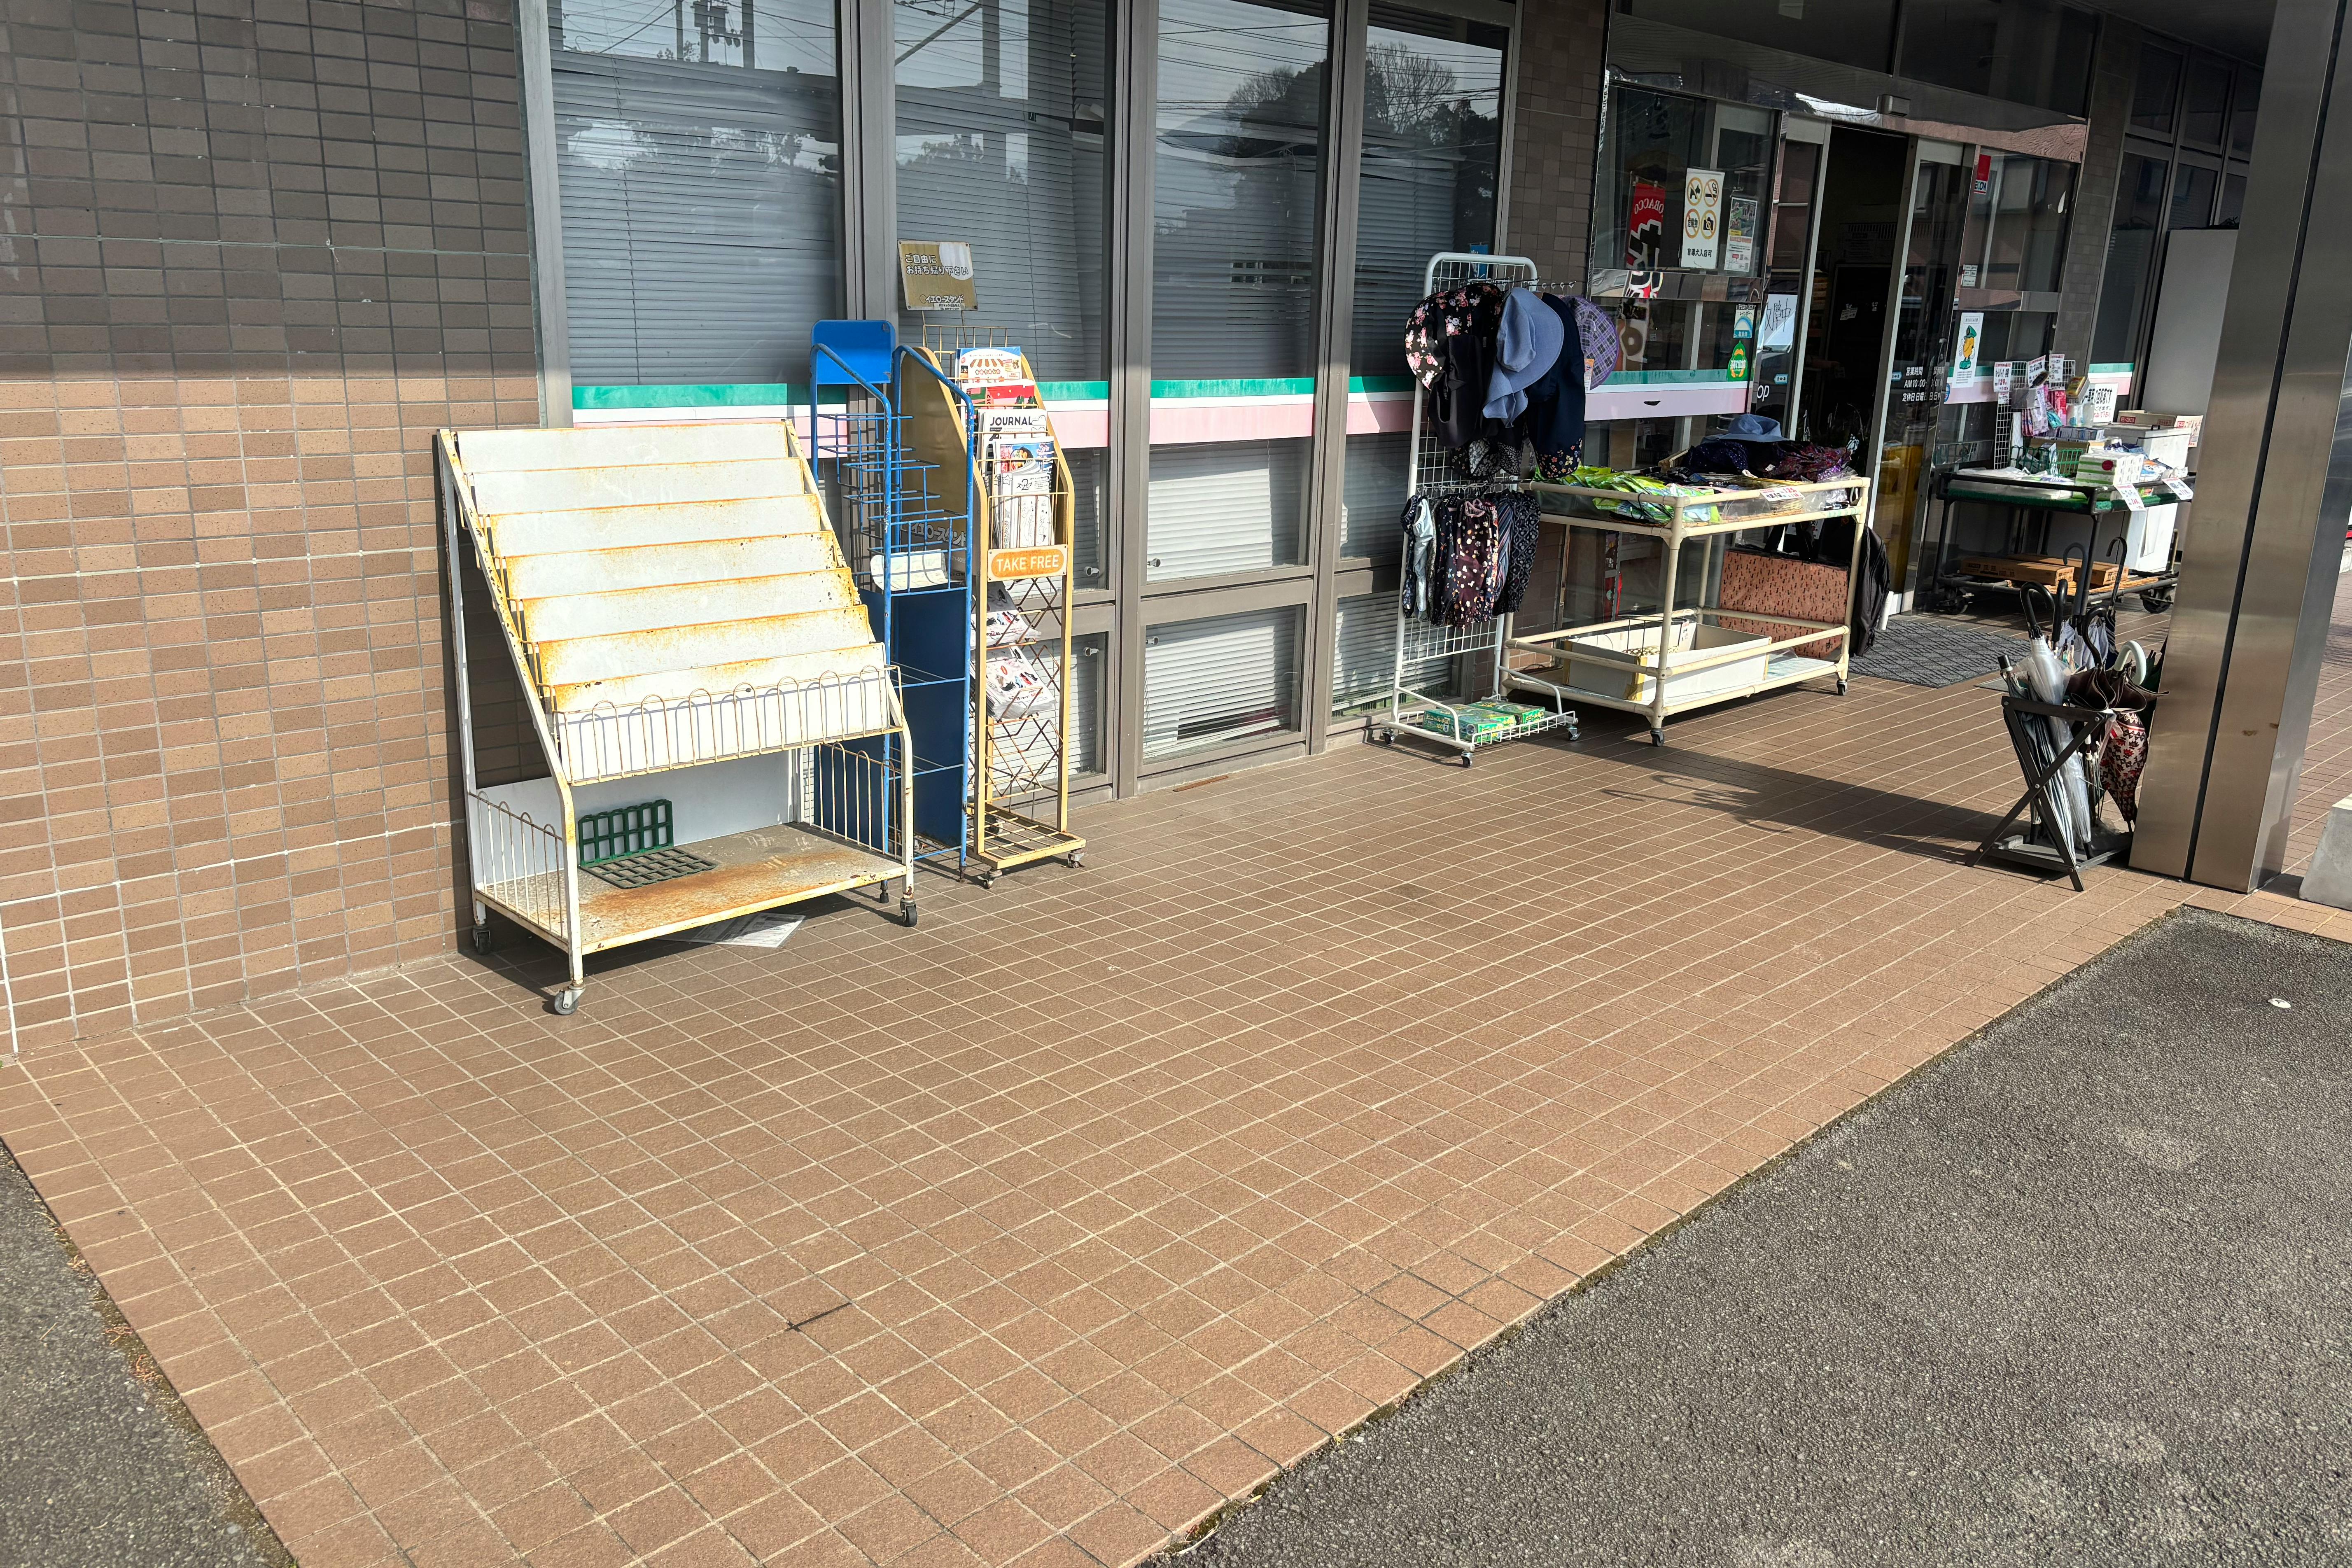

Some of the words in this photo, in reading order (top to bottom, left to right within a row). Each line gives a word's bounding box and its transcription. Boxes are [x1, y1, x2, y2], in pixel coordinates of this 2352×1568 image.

[1975, 181, 1987, 191] ECOM
[905, 253, 937, 264] ご自由に
[906, 265, 969, 275] お持ち帰り下さい
[926, 294, 964, 303] イエロースタンド
[1906, 366, 1923, 376] 営業時間
[989, 416, 1033, 426] JOURNAL
[996, 557, 1027, 572] TAKE
[1030, 554, 1059, 569] FREE
